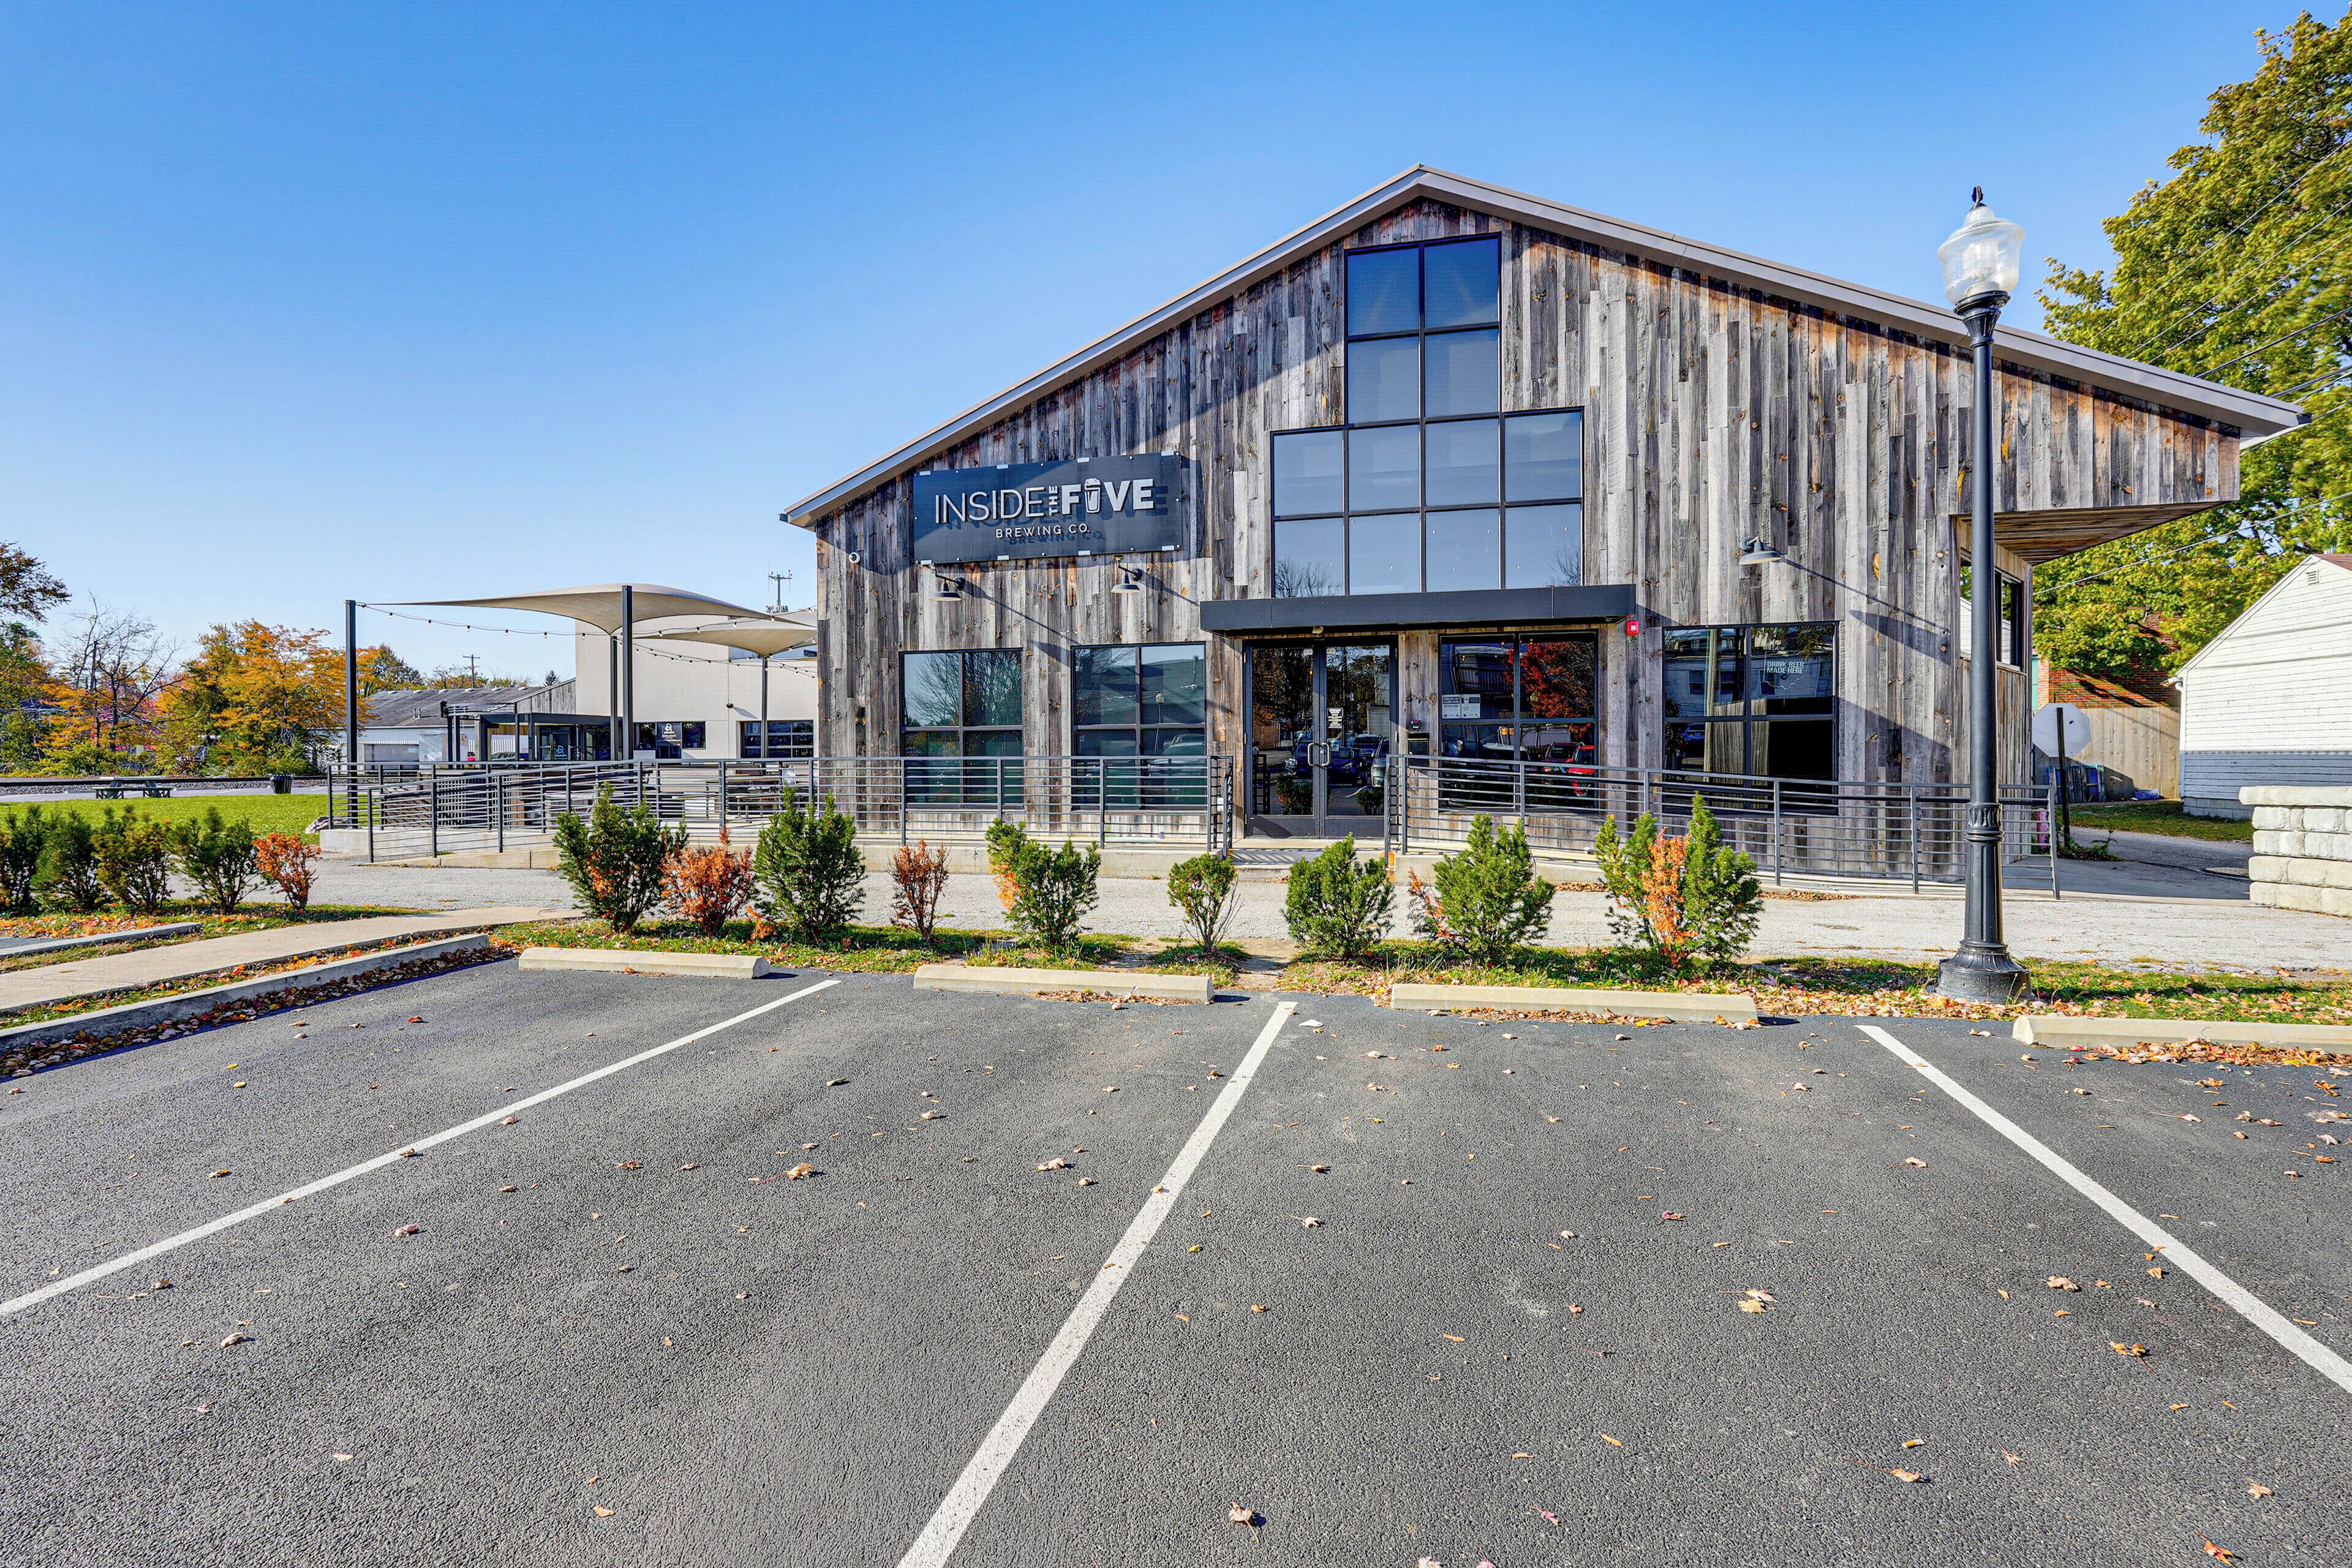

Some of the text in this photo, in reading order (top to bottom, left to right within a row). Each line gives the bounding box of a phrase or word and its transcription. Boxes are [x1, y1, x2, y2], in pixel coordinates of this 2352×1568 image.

[935, 486, 1044, 524] INSIDE
[1049, 485, 1058, 516] THE
[995, 522, 1091, 538] BREWING CO.
